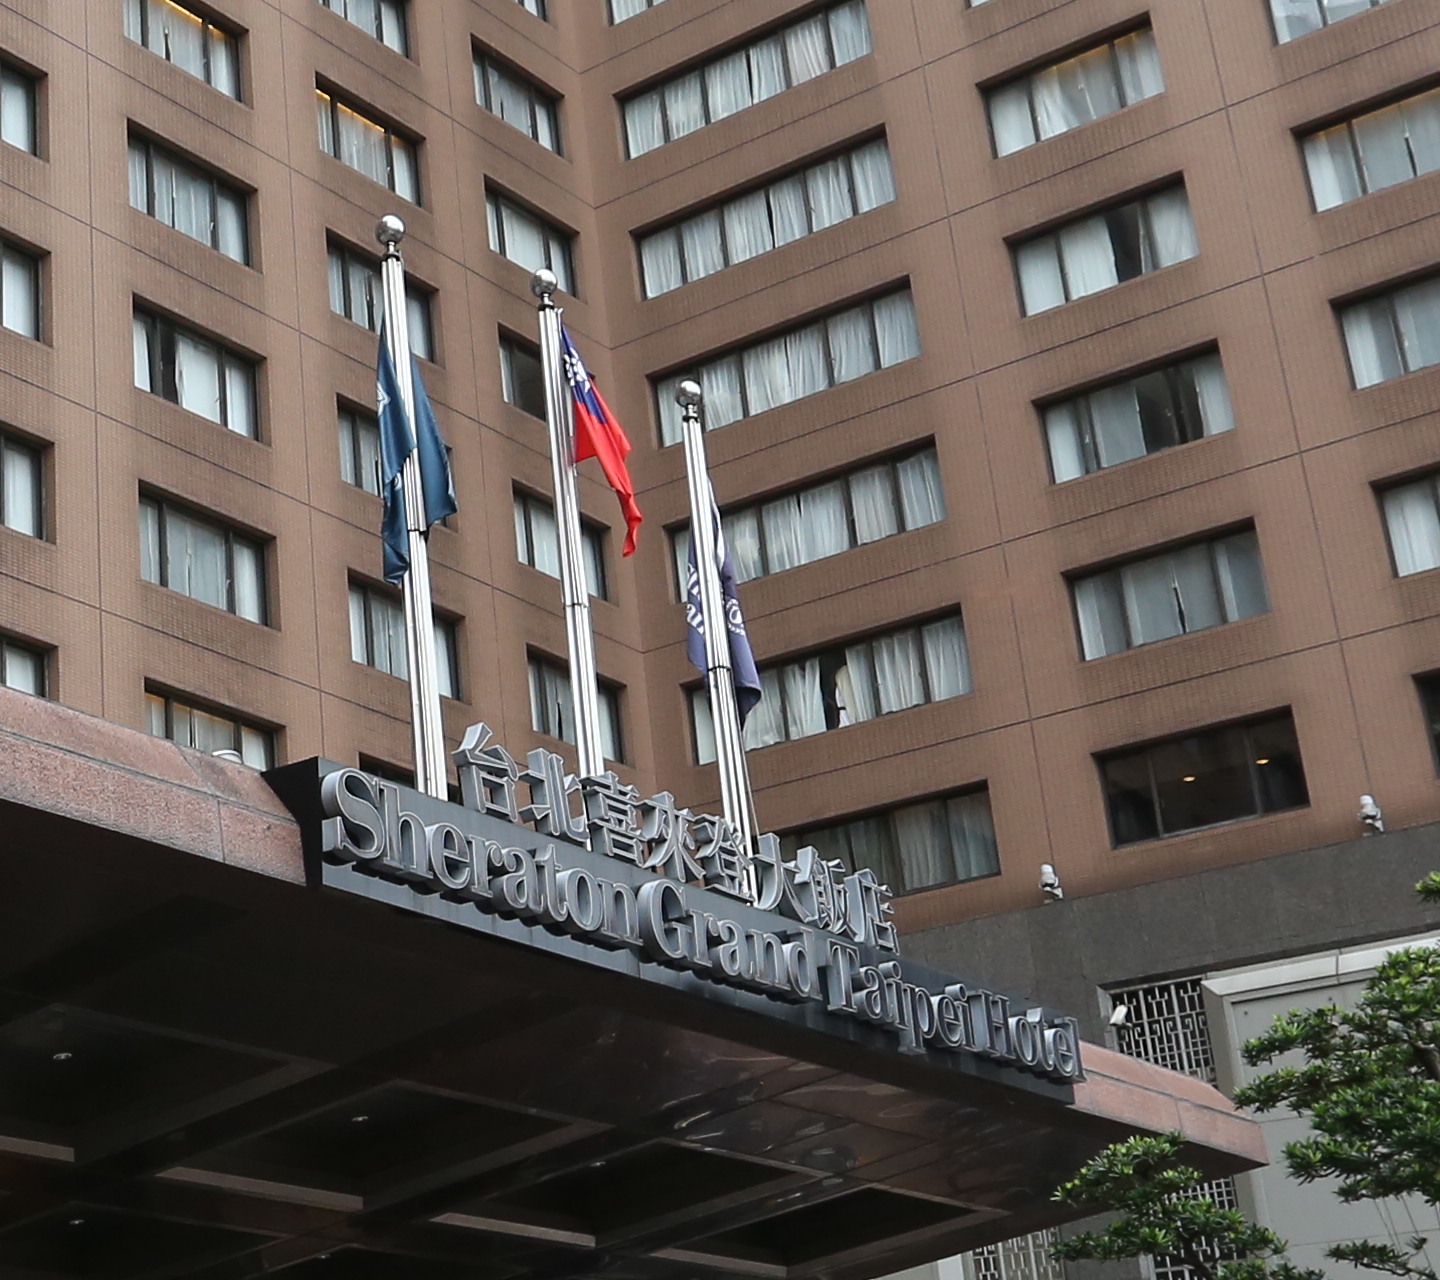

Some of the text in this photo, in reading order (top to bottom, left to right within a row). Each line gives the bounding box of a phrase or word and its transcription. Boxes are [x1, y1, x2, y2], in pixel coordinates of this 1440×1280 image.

[320, 767, 1087, 1083] Sheraton Grand Taipei Hotel
[451, 721, 900, 957] 台北喜來登大飯店
